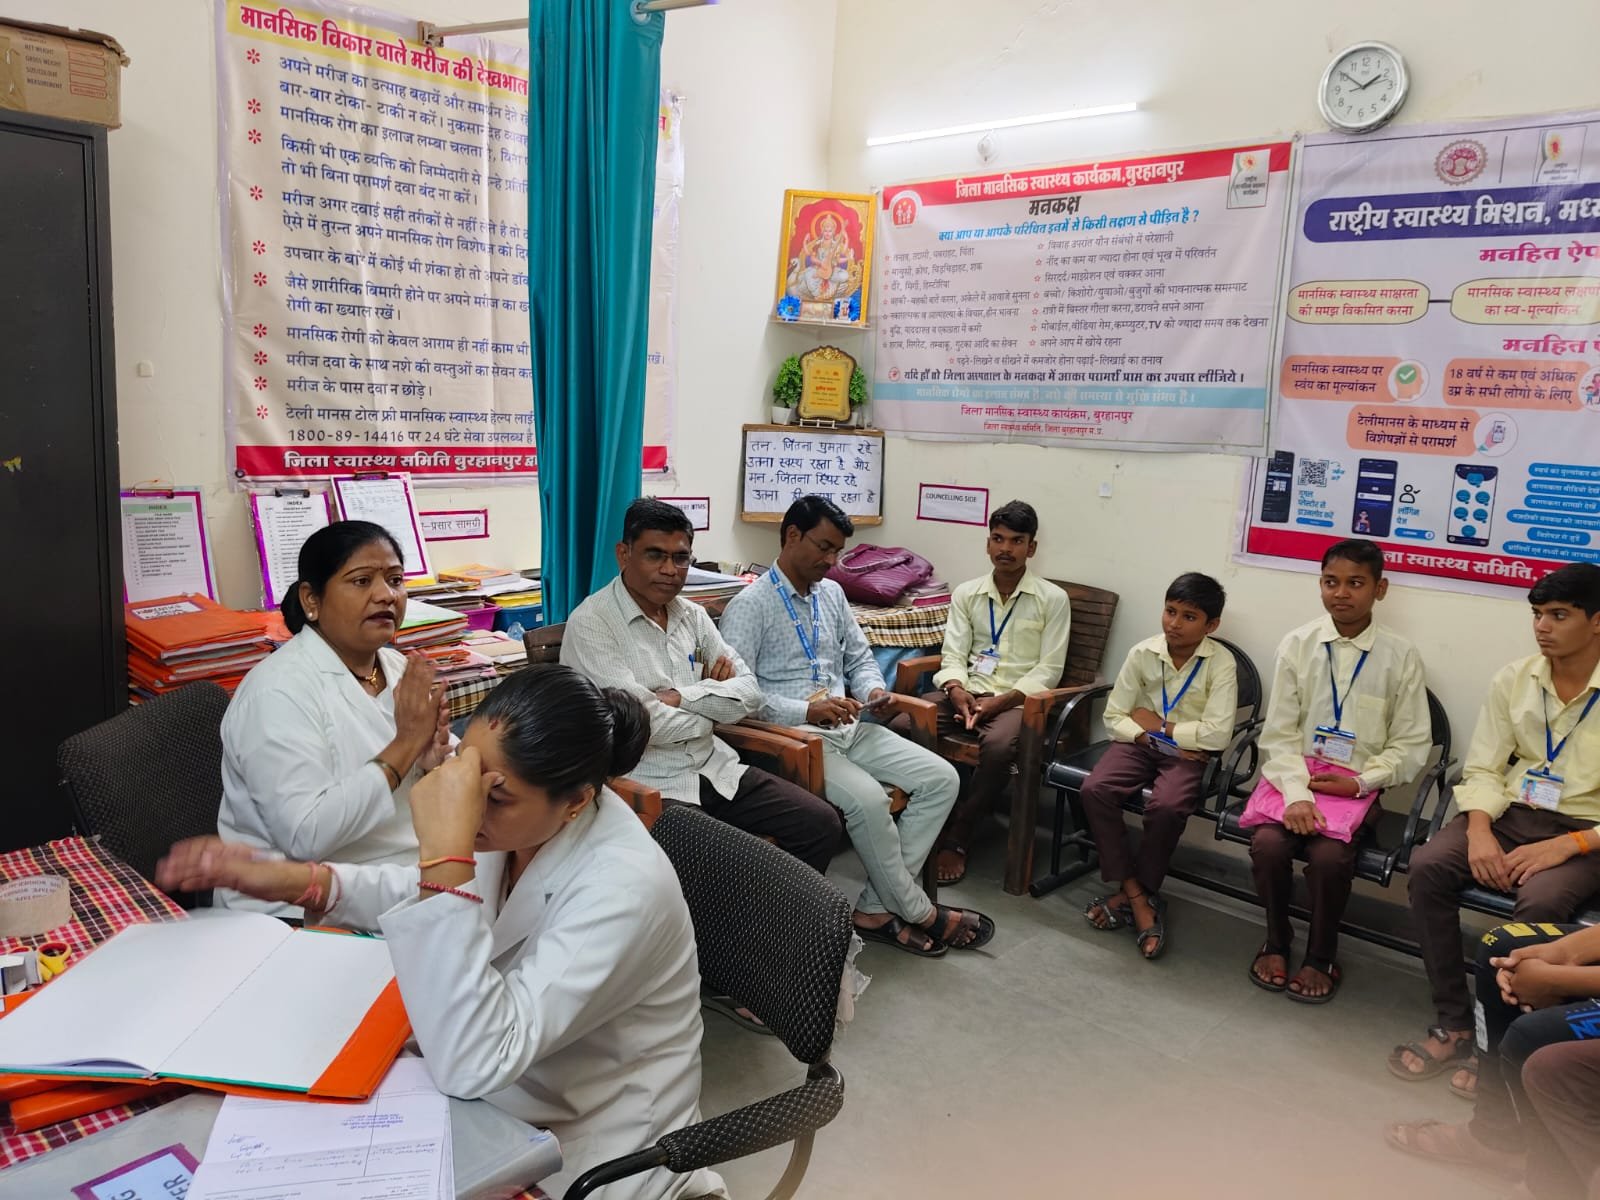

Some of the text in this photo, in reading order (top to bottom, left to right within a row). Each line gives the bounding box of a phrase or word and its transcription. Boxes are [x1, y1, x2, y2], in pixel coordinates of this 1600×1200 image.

[240, 6, 317, 42] मानसिक
[322, 20, 372, 56] विकार
[376, 39, 407, 65] वाले
[410, 48, 448, 76] मरीज
[453, 56, 472, 81] की
[281, 160, 297, 174] तो
[301, 160, 317, 178] भी
[321, 164, 348, 184] बिना
[353, 171, 390, 190] परामर्श
[394, 180, 416, 195] दवा
[419, 181, 435, 200] बंद
[439, 186, 450, 201] ना
[956, 178, 980, 198] जिला
[983, 173, 1028, 194] मानसिक
[1030, 173, 1070, 190] स्वास्थ्य
[1029, 196, 1081, 216] मनकक्ष
[939, 231, 953, 241] क्या
[956, 231, 971, 240] आप
[974, 229, 984, 238] या
[985, 224, 1011, 237] आपके
[1048, 218, 1069, 234] इनमें
[1072, 219, 1078, 231] से
[1082, 214, 1106, 230] किसी
[1109, 215, 1136, 228] लक्षण
[1139, 209, 1147, 225] से
[1182, 207, 1190, 224] है
[1329, 202, 1390, 235] राष्ट्रीय
[1392, 204, 1470, 227] स्वास्थ्य
[1480, 242, 1562, 262] मनहित
[1298, 287, 1418, 299] मानसिक स्वास्थ्य साक्षरता
[1467, 286, 1560, 298] मानसिक स्वास्थ्य
[1316, 306, 1339, 317] समझ
[1342, 304, 1383, 316] विकसित
[1387, 306, 1413, 316] करना
[1485, 305, 1500, 316] का
[286, 325, 337, 342] मानसिक
[342, 326, 364, 344] रोगी
[388, 330, 418, 348] केवल
[422, 337, 453, 351] आराम
[458, 337, 468, 352] ही
[472, 336, 488, 352] नहीं
[491, 342, 513, 354] काम
[517, 340, 529, 355] भी
[1503, 334, 1586, 354] मनहित
[905, 368, 918, 379] यदि
[931, 369, 940, 379] तो
[944, 370, 965, 380] जिला
[1004, 369, 1011, 380] के
[1048, 370, 1056, 381] में
[1088, 370, 1121, 382] परामर्श
[1164, 373, 1194, 382] उपचार
[1291, 363, 1384, 376] मानसिक स्वास्थ्य पर
[1450, 369, 1463, 379] 18
[1485, 369, 1495, 379] से
[1499, 370, 1516, 380] कम
[1541, 369, 1577, 382] अधिक
[1316, 381, 1330, 391] का
[1333, 380, 1376, 395] मूल्यांकन
[1479, 385, 1500, 398] सभी
[1535, 387, 1545, 400] के
[1550, 388, 1572, 404] लिए
[286, 402, 312, 419] टेली
[317, 408, 350, 420] मानस
[356, 406, 378, 420] टोल
[382, 406, 396, 421] फ्री
[399, 407, 445, 422] मानसिक
[449, 412, 487, 424] स्वास्थ्य
[961, 404, 982, 416] जिला
[985, 405, 1014, 416] मानसिक
[1017, 408, 1049, 417] स्वास्थ्य
[1408, 414, 1418, 429] के
[1422, 418, 1456, 430] माध्यम
[1460, 417, 1470, 432] से
[289, 429, 404, 442] 1800-89-14416
[408, 432, 421, 443] पर
[426, 430, 440, 442] 24
[444, 428, 460, 443] घंटे
[463, 428, 484, 443] सेवा
[1410, 432, 1419, 445] से
[1421, 433, 1456, 448] परामर्श
[284, 450, 329, 468] जिला
[333, 454, 398, 468] स्वास्थ्य
[400, 450, 450, 468] समिति
[1407, 553, 1469, 571] स्वास्थ्य
